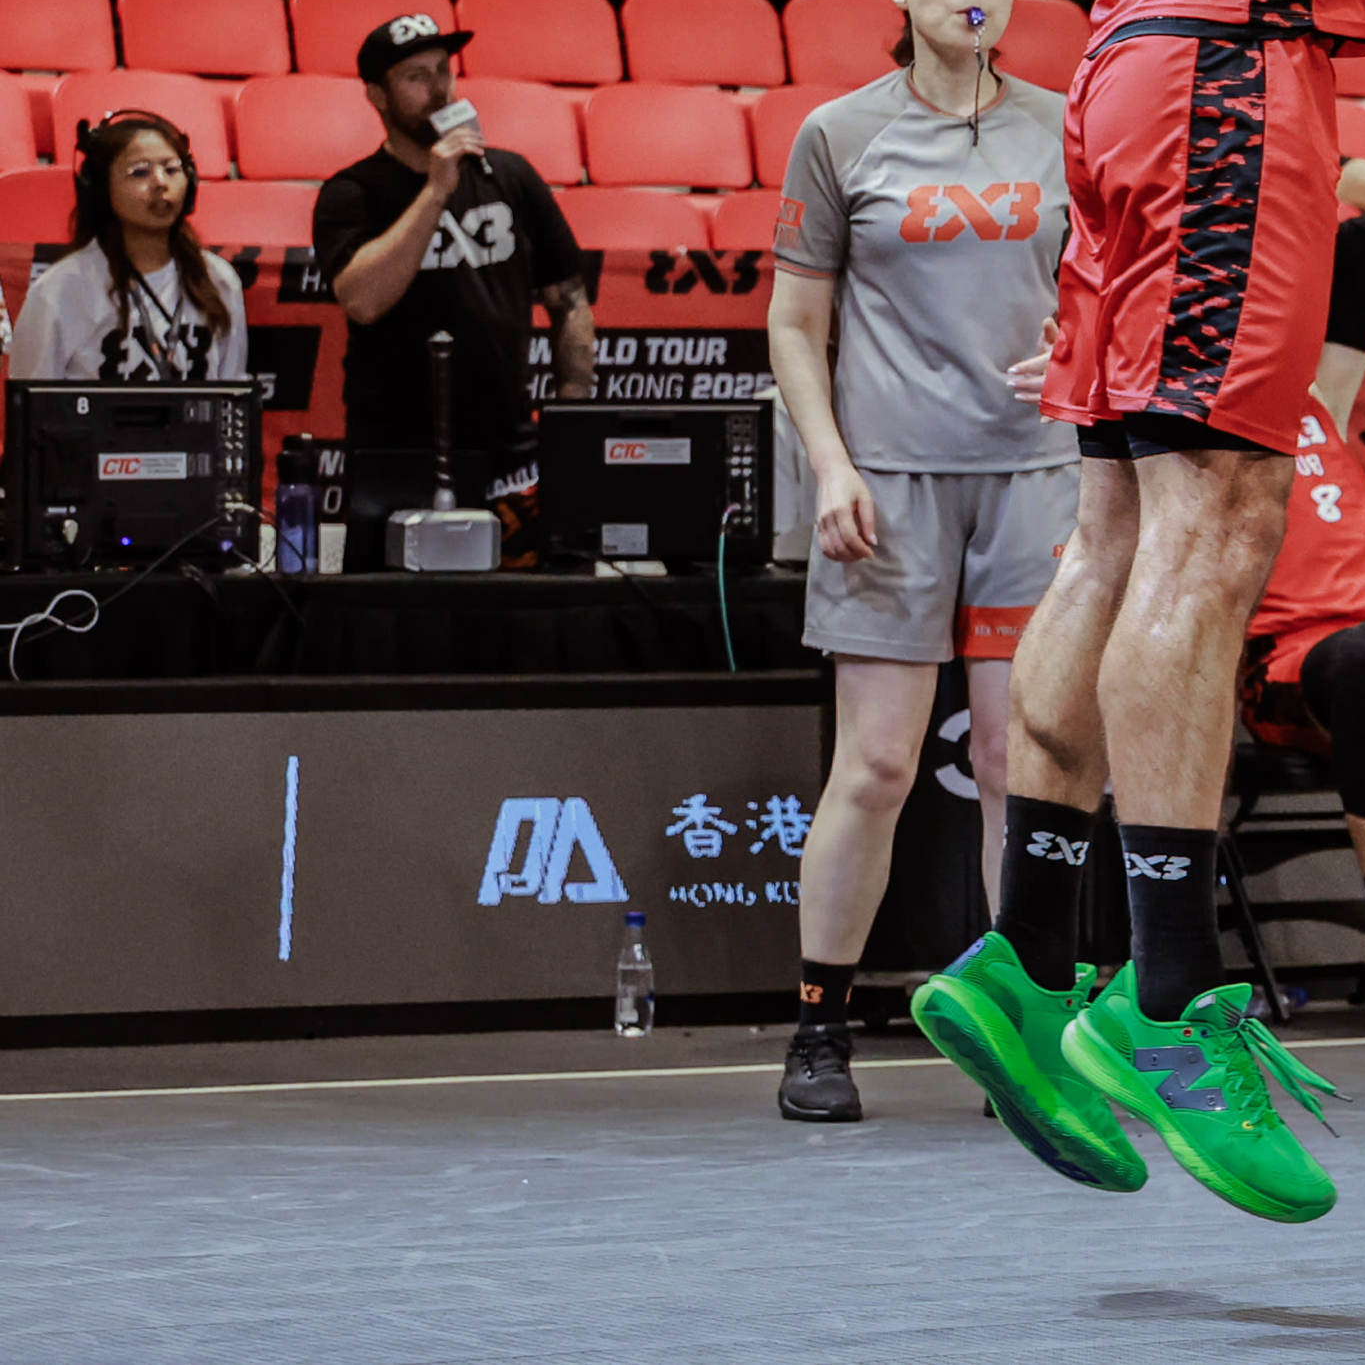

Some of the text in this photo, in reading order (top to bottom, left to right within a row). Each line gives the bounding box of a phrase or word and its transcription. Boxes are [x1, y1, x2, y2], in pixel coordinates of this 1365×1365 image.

[899, 181, 1043, 244] 3X3
[645, 336, 728, 366] TOUR
[606, 373, 683, 401] KONG
[76, 396, 90, 415] 8
[609, 442, 648, 460] CTC
[102, 457, 141, 477] CTC
